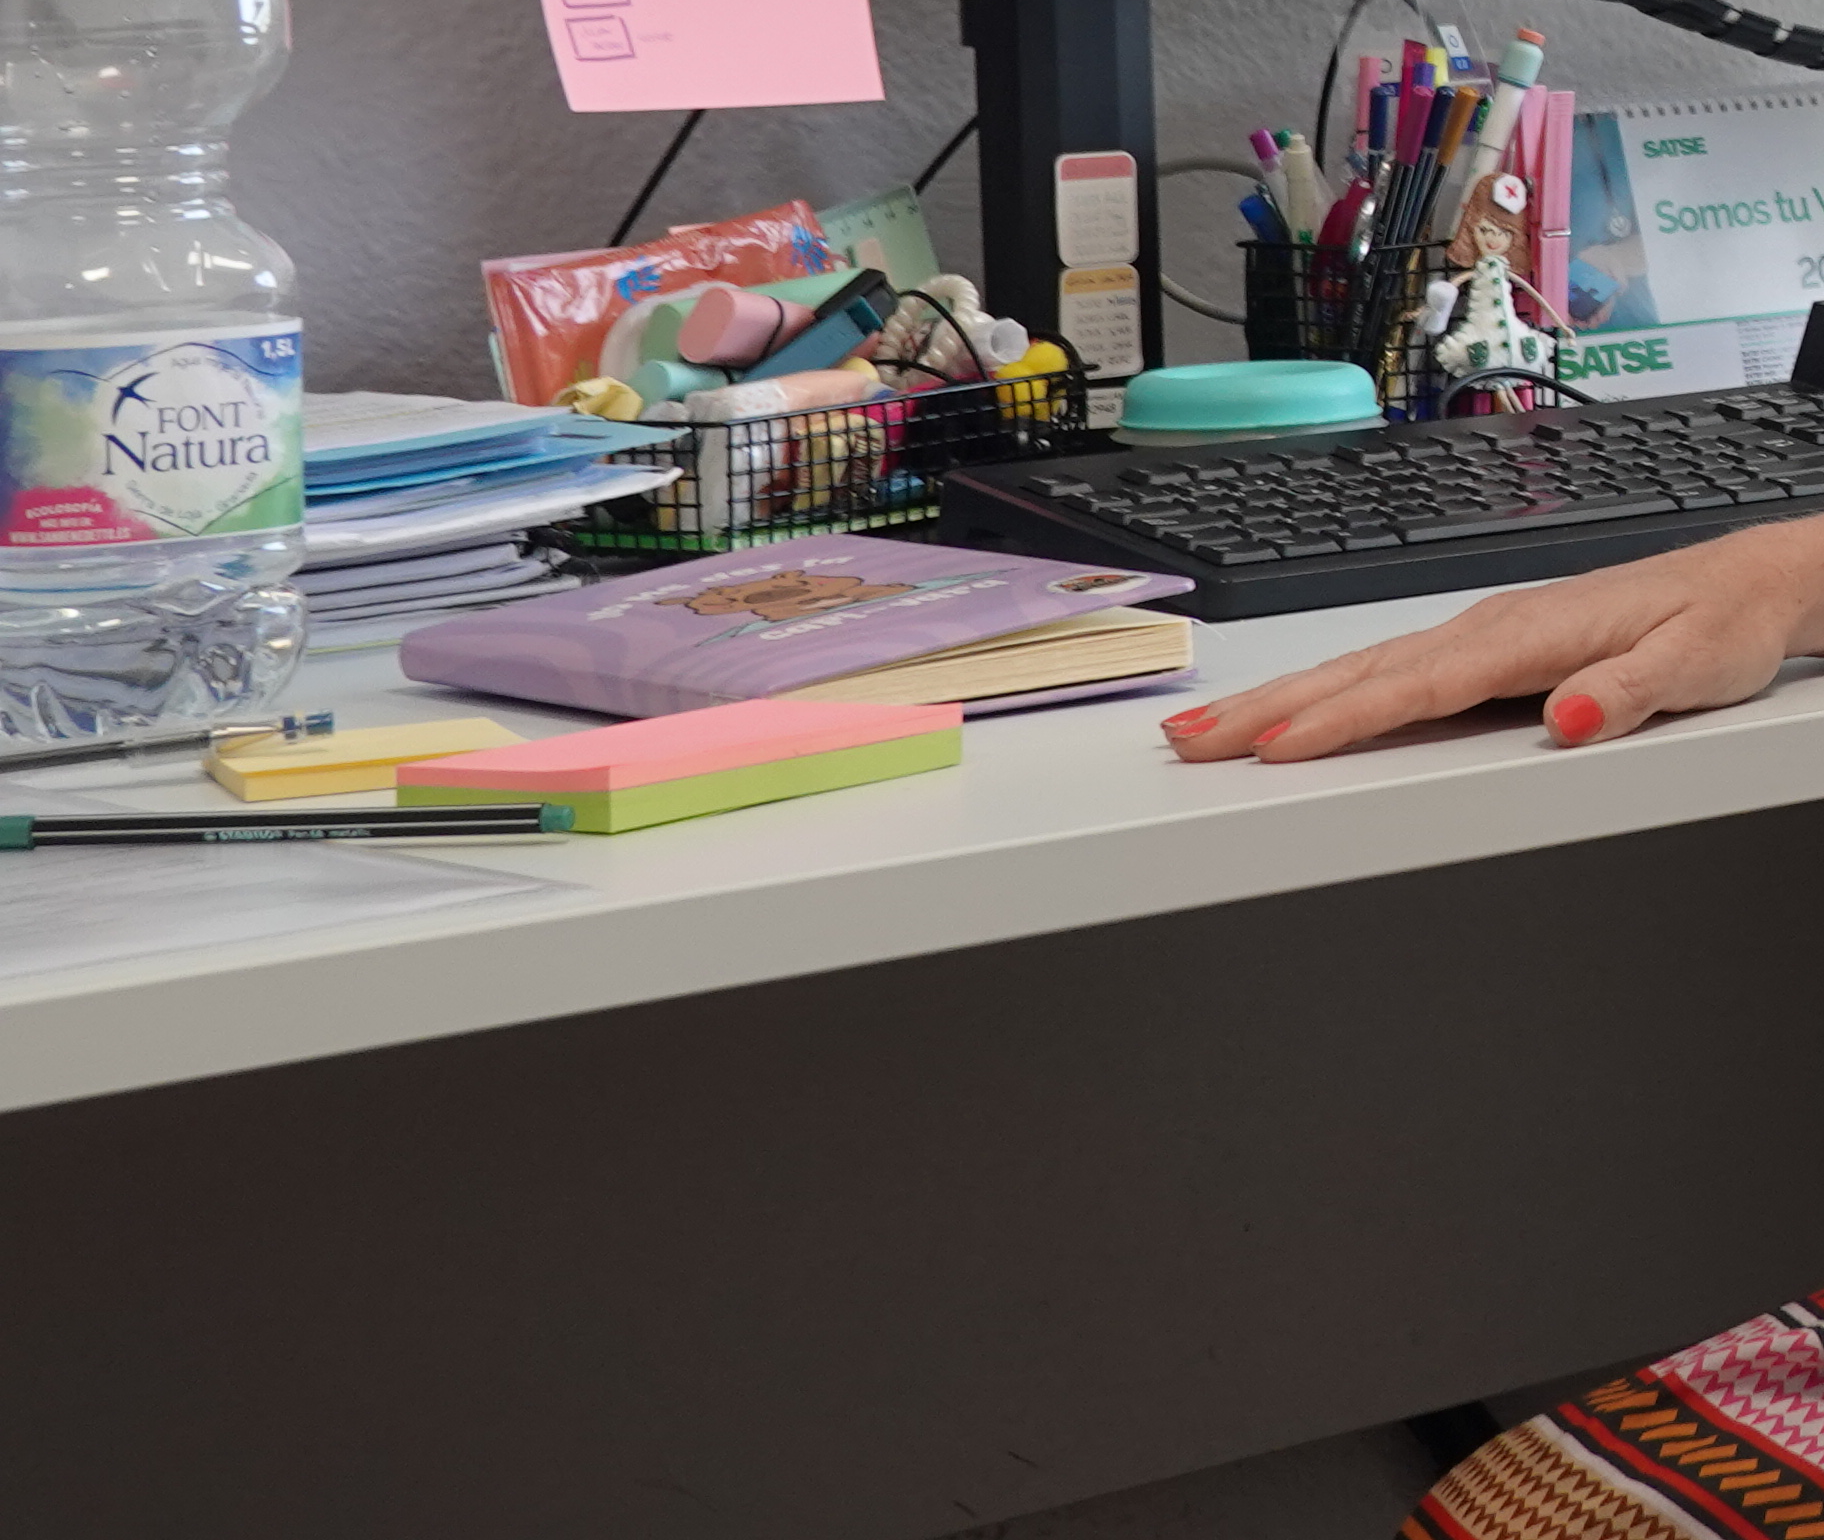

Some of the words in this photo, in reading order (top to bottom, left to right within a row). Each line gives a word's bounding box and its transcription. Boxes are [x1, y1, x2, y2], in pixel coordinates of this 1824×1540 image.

[1643, 137, 1708, 159] SATSE
[1655, 200, 1773, 234] Somos
[1775, 191, 1813, 223] tu
[261, 338, 296, 359] 1,5L
[1557, 338, 1673, 381] SATSE
[157, 401, 247, 434] FONT
[102, 431, 271, 476] Natura
